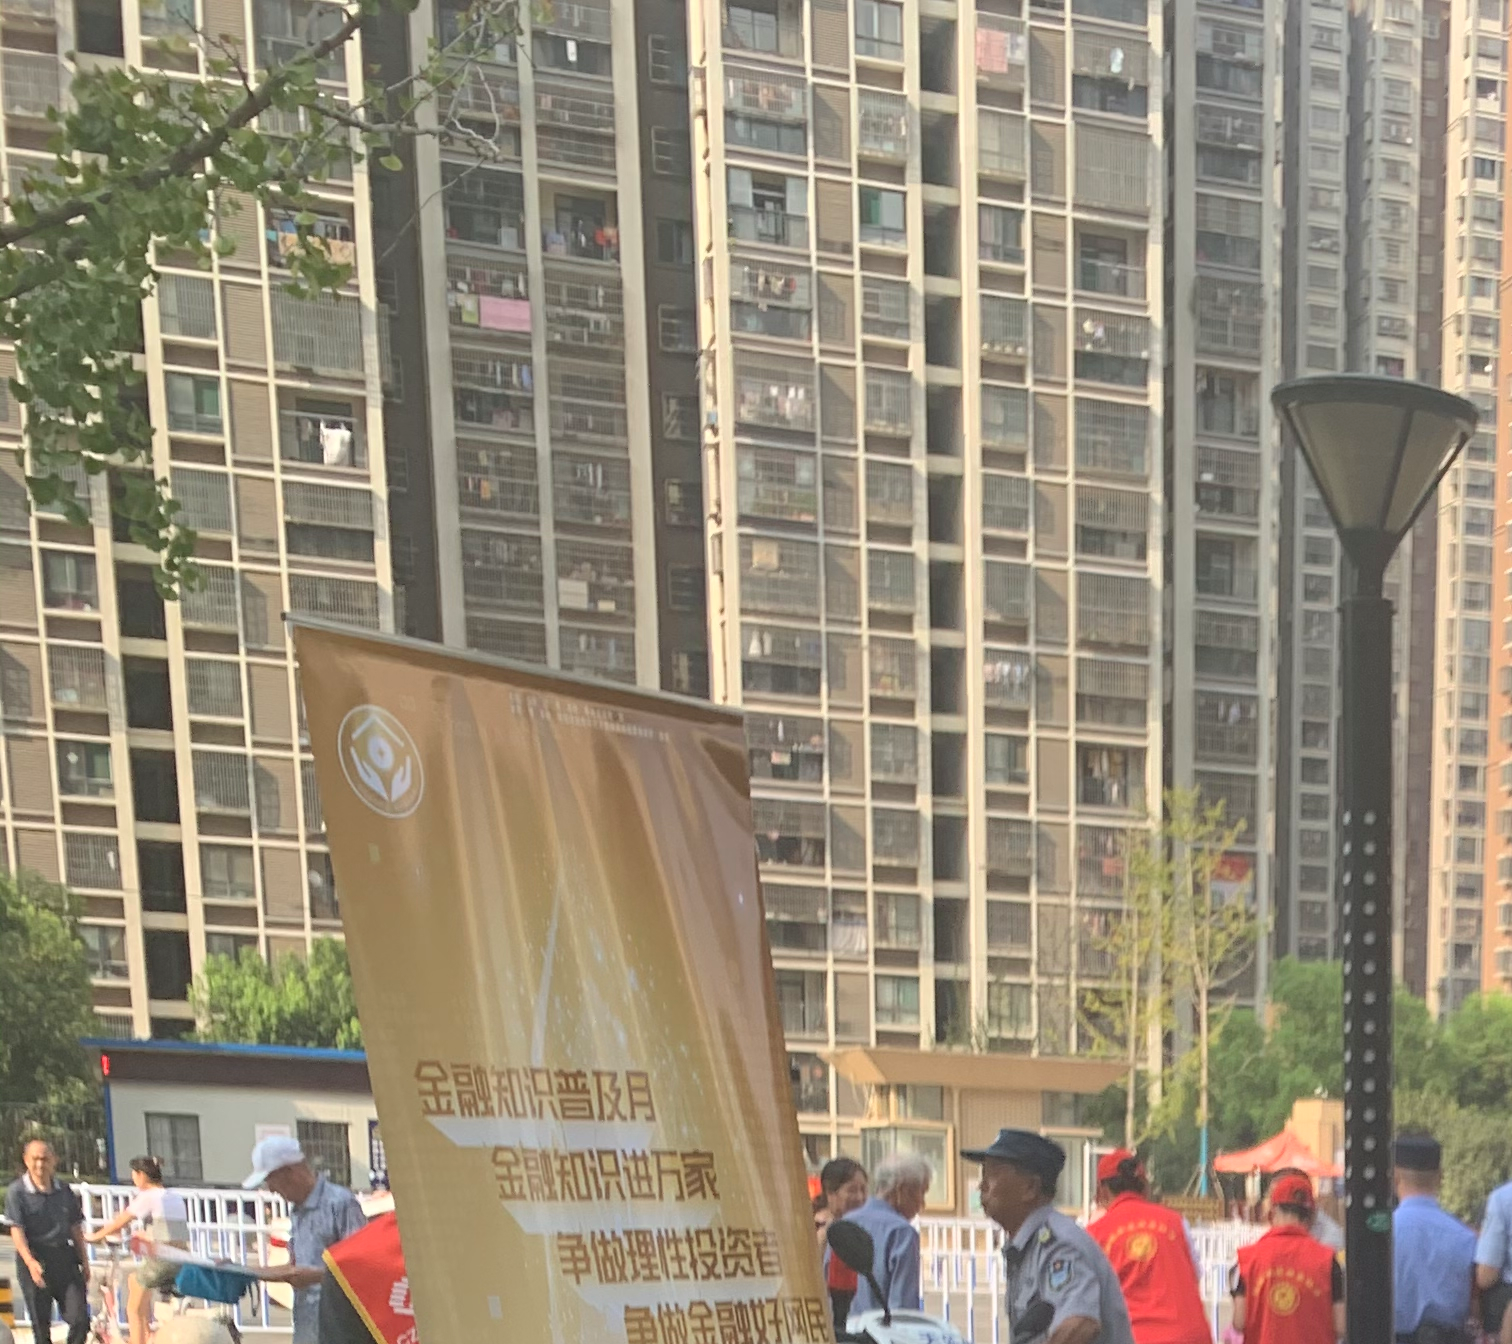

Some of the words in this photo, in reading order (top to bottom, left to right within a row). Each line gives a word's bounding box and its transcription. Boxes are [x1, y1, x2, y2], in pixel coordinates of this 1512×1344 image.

[414, 1060, 657, 1122] 金融知识普及月
[491, 1145, 721, 1203] 金融知识进万家
[557, 1228, 783, 1285] 争做理性投资者
